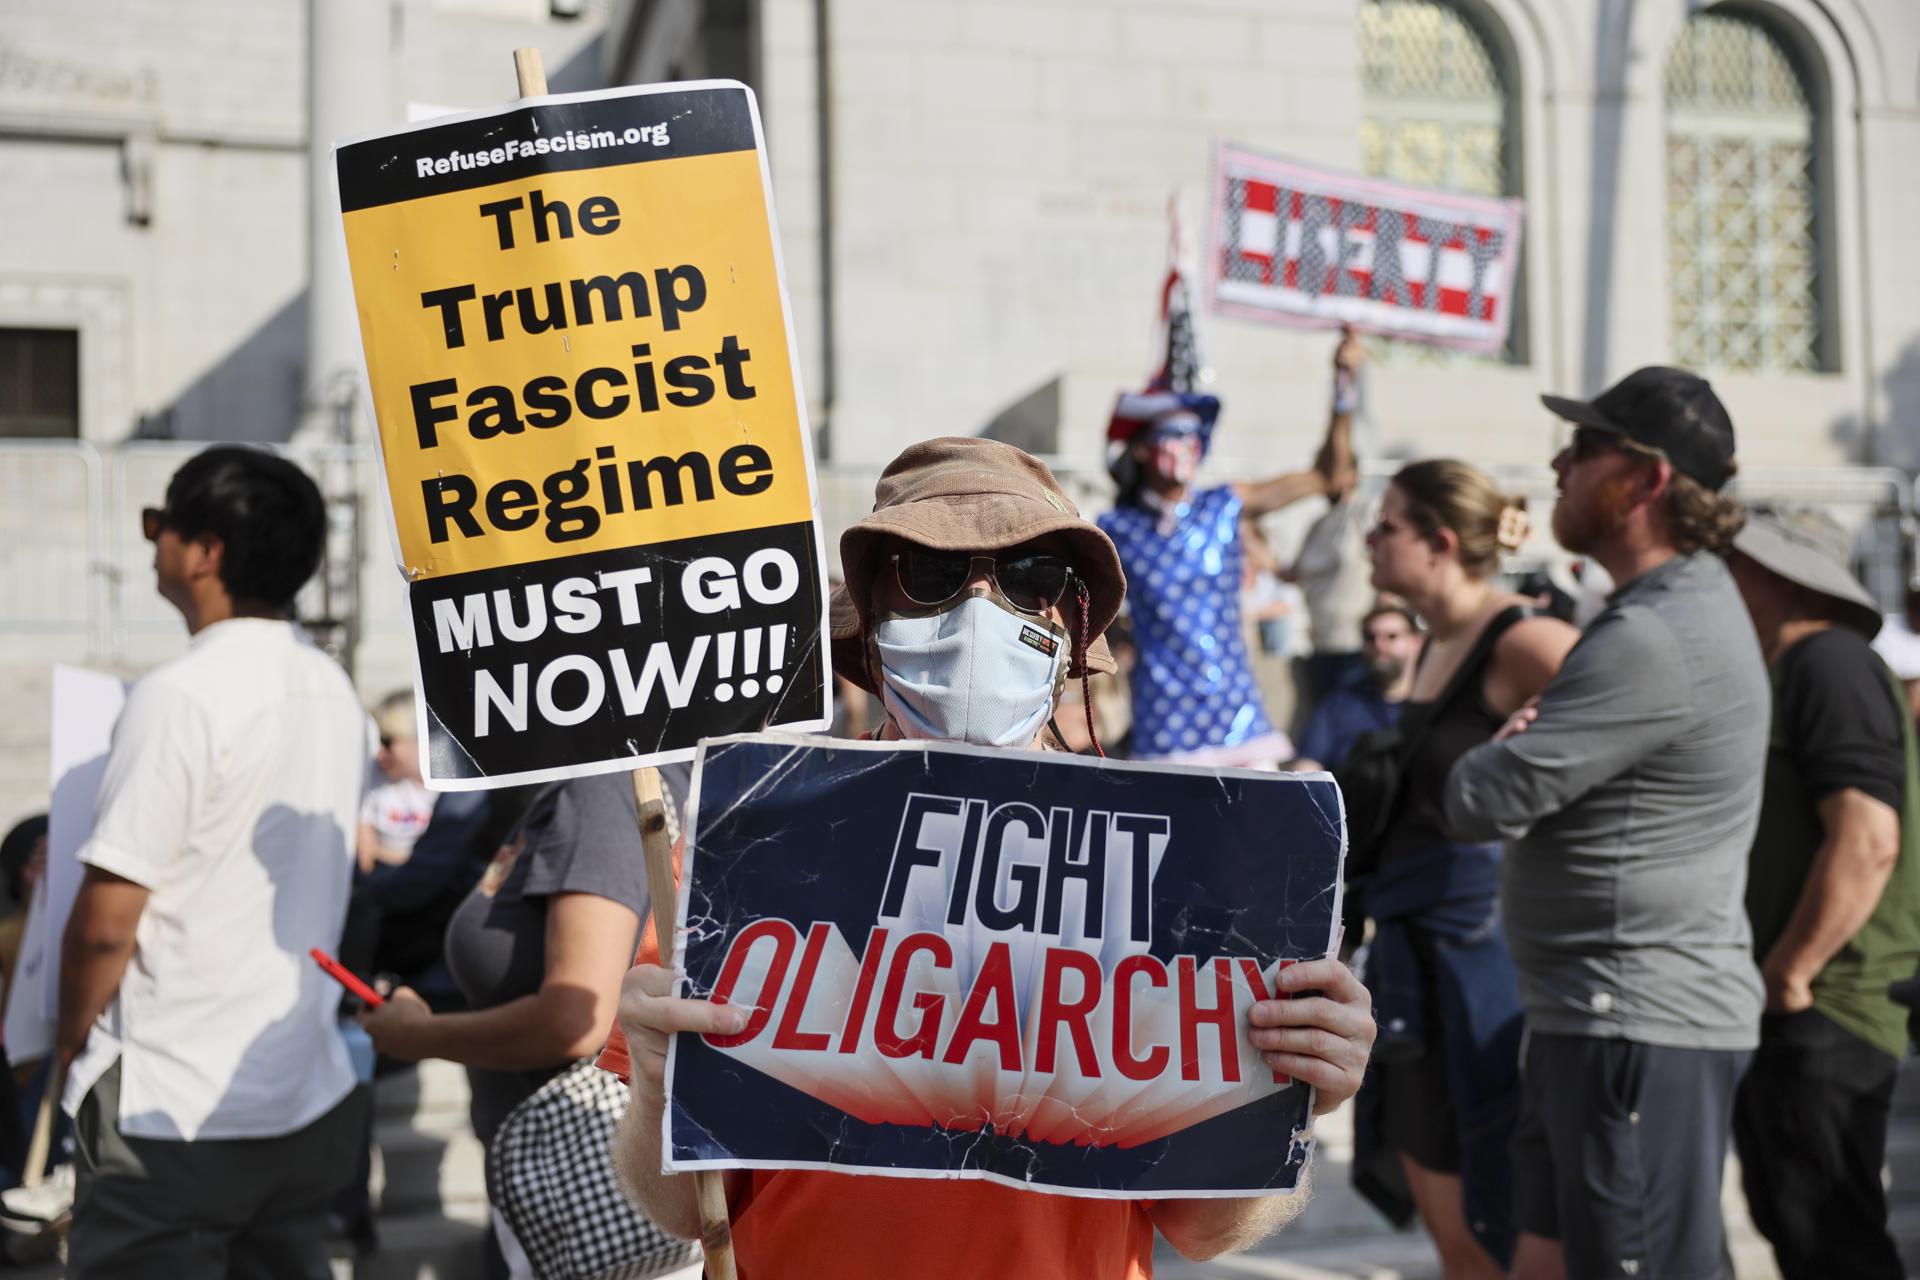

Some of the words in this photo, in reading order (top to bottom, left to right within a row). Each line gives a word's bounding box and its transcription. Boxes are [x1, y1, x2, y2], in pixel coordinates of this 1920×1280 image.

[416, 122, 670, 178] RefuseFascism.org
[479, 189, 621, 250] The
[421, 264, 707, 349] Trump
[409, 335, 756, 449] Fascist
[421, 443, 774, 544] Regime
[432, 567, 652, 653] MUST
[681, 548, 799, 614] GO
[474, 623, 788, 738] NOW!!!
[878, 792, 1171, 957] FIGHT
